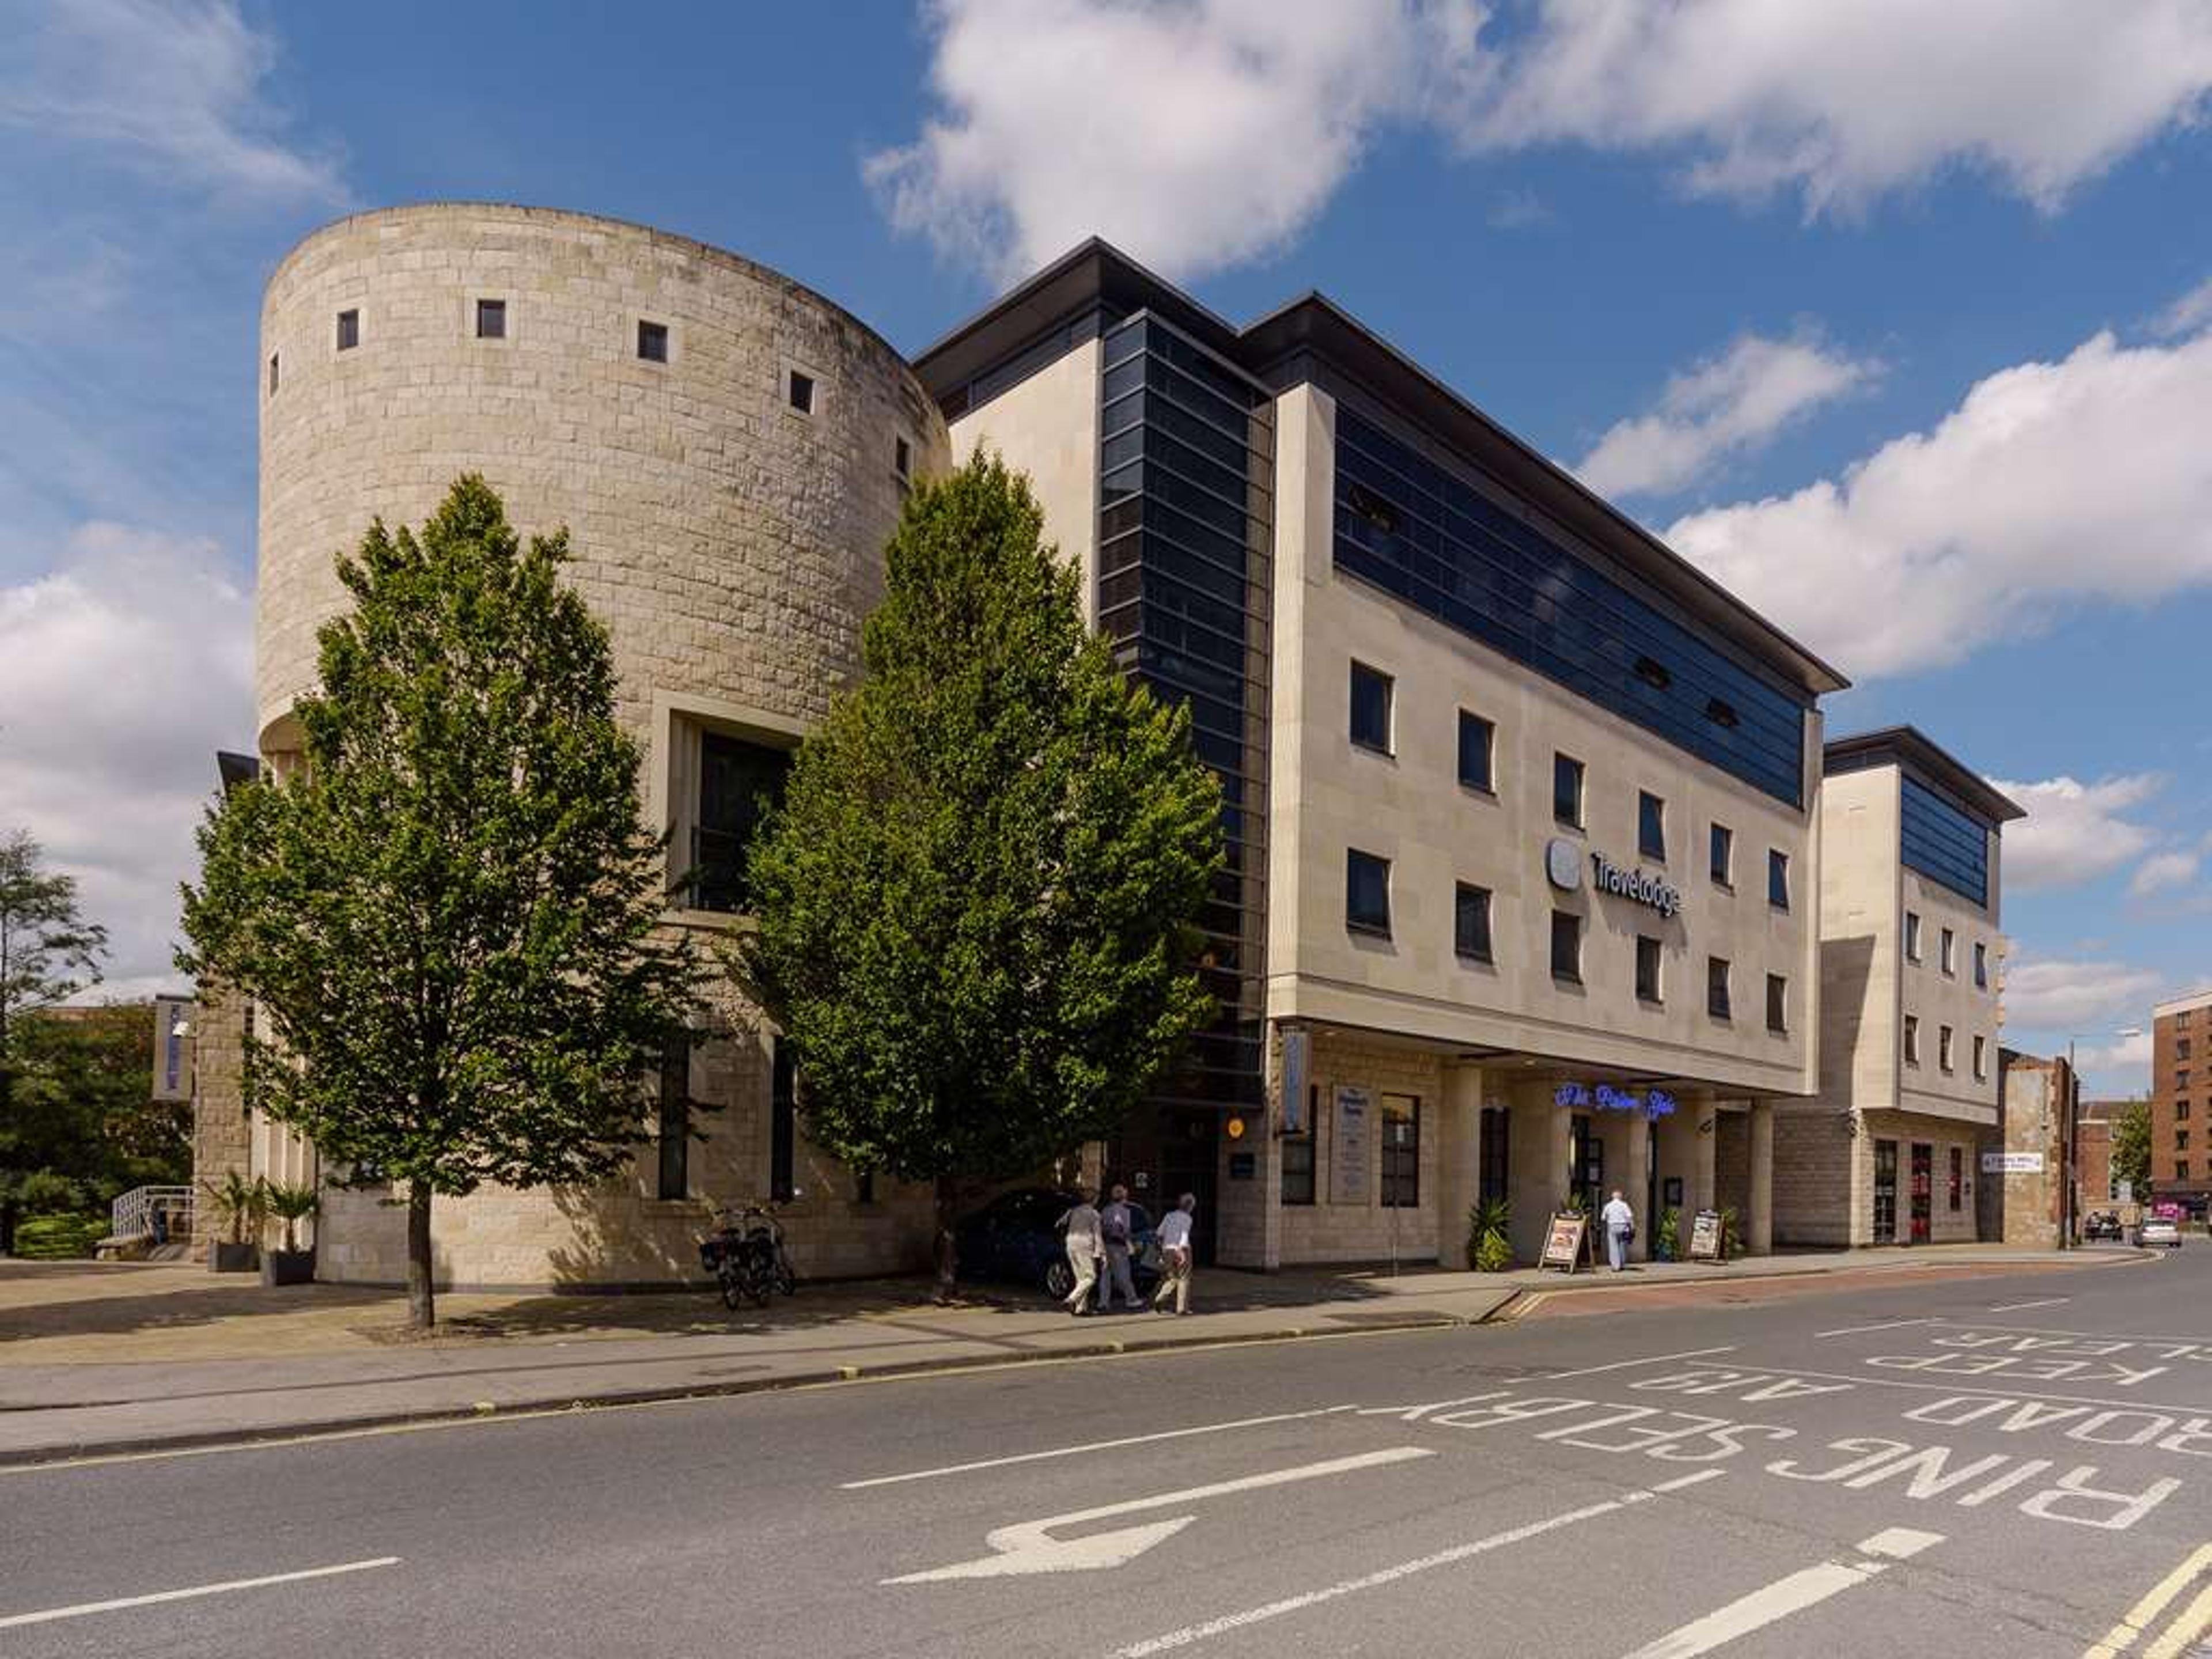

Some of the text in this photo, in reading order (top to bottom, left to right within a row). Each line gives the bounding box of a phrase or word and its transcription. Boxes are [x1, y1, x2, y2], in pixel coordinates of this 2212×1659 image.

[1590, 850, 1686, 918] Travelodge
[1628, 1372, 1856, 1402] A19
[1866, 1354, 2171, 1385] KEEP
[1356, 1391, 1798, 1460] SELBY
[1764, 1438, 2183, 1530] RING
